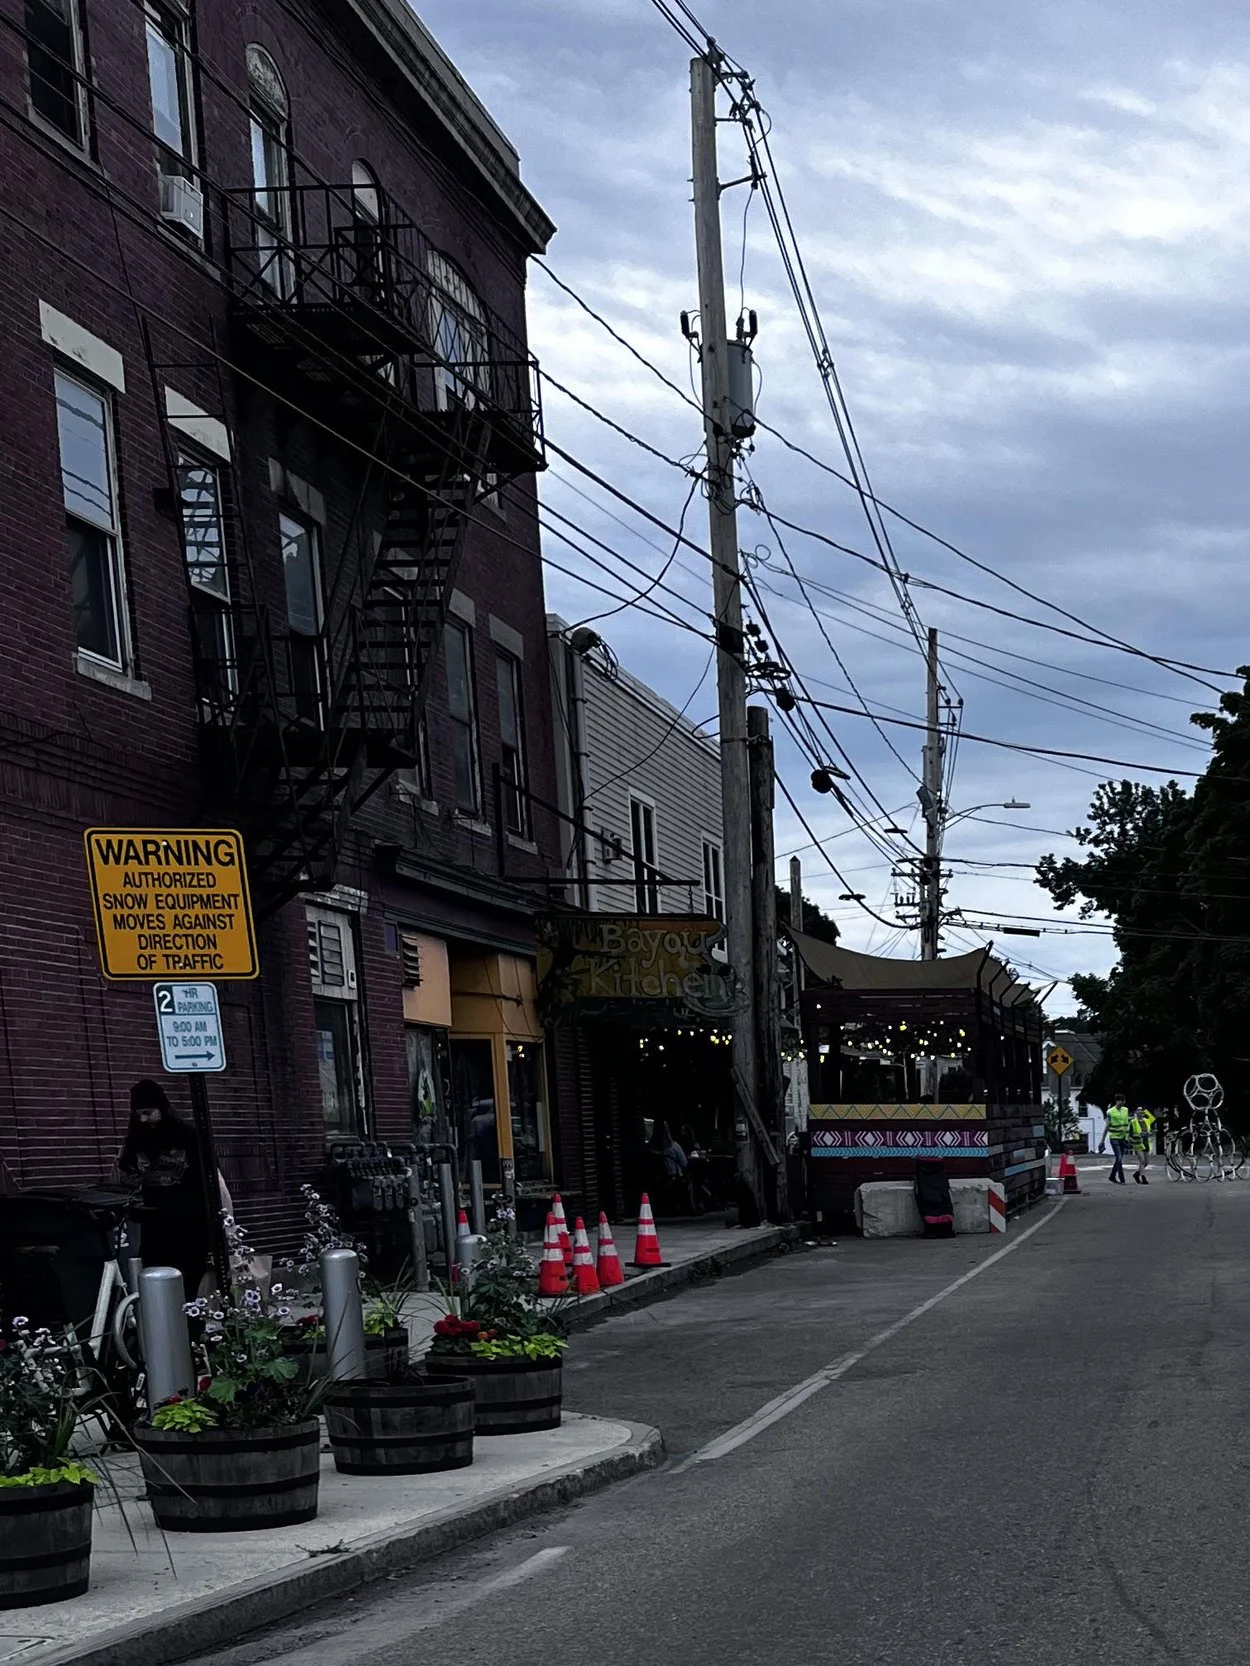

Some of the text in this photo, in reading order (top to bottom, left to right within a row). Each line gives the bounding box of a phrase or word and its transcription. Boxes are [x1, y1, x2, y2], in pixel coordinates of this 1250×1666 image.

[94, 838, 236, 867] WARNING
[122, 872, 217, 890] AUTHORIZED
[103, 893, 240, 911] SNOW EQUIPMENT
[113, 914, 235, 931] MOVES AGAINST
[137, 934, 218, 951] DIRECTION
[599, 924, 709, 968] Bayou
[137, 953, 224, 971] OF TRAFFIC
[588, 957, 730, 1000] Kitchen
[158, 990, 173, 1013] 2
[177, 1001, 214, 1013] PARKING
[173, 1021, 207, 1033] 9:00 AM
[166, 1035, 218, 1047] TO 5:00 PM
